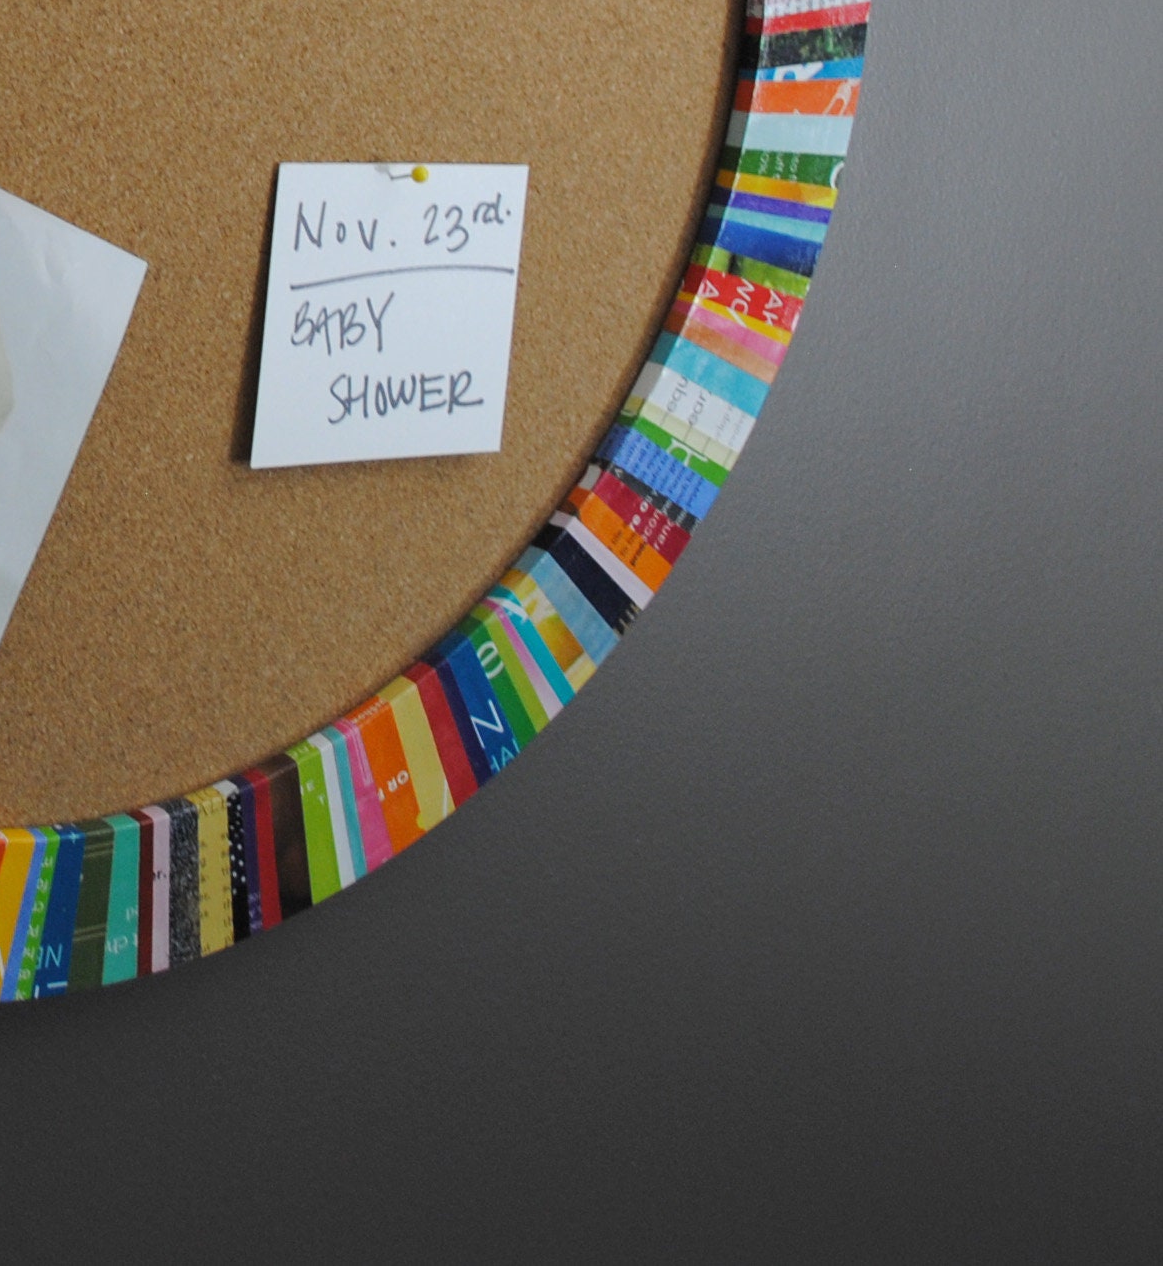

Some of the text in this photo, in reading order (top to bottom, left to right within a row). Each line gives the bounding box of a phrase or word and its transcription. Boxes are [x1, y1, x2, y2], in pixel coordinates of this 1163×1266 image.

[293, 200, 396, 253] Nov.
[291, 291, 395, 356] BABY
[328, 371, 485, 424] SHOWER
